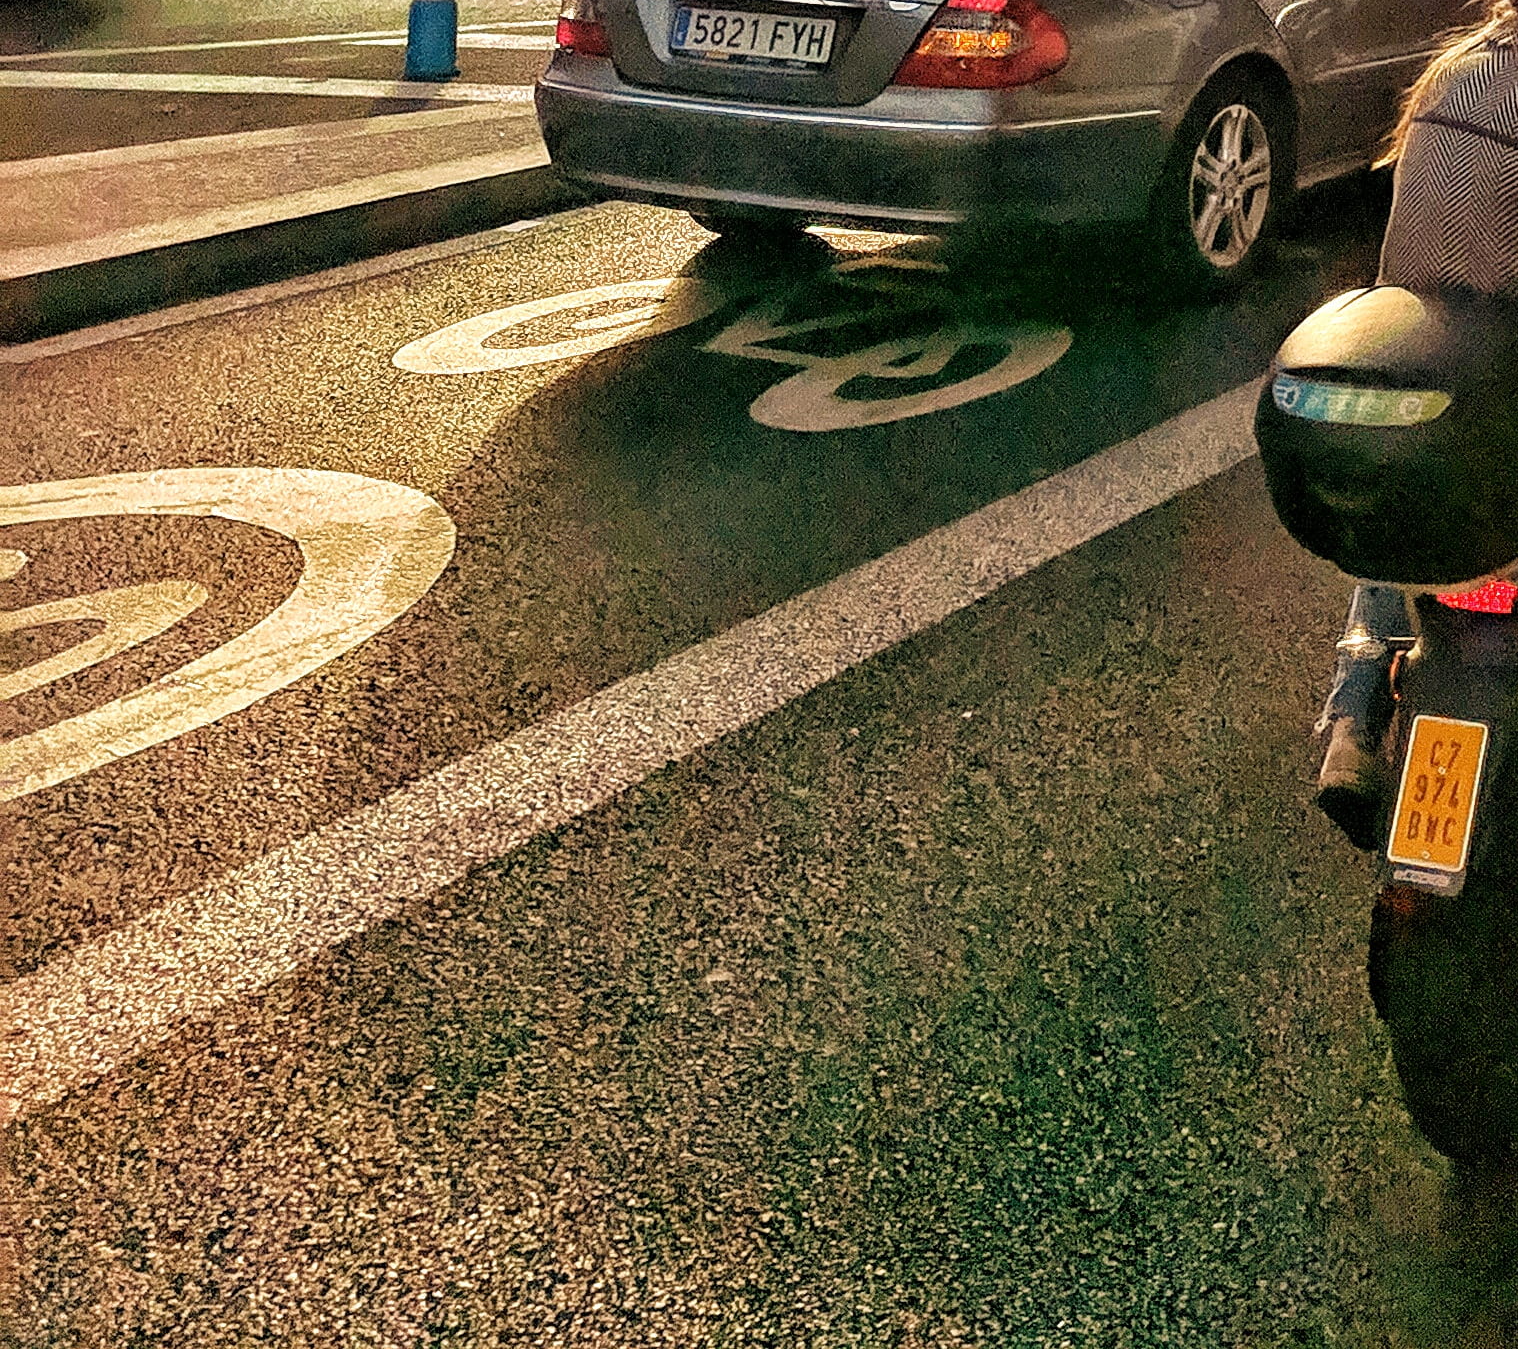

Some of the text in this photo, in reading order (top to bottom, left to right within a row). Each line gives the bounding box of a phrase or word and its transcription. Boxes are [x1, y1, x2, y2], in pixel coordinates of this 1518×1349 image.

[693, 14, 828, 59] 5821 FYH
[1430, 740, 1462, 769] C7
